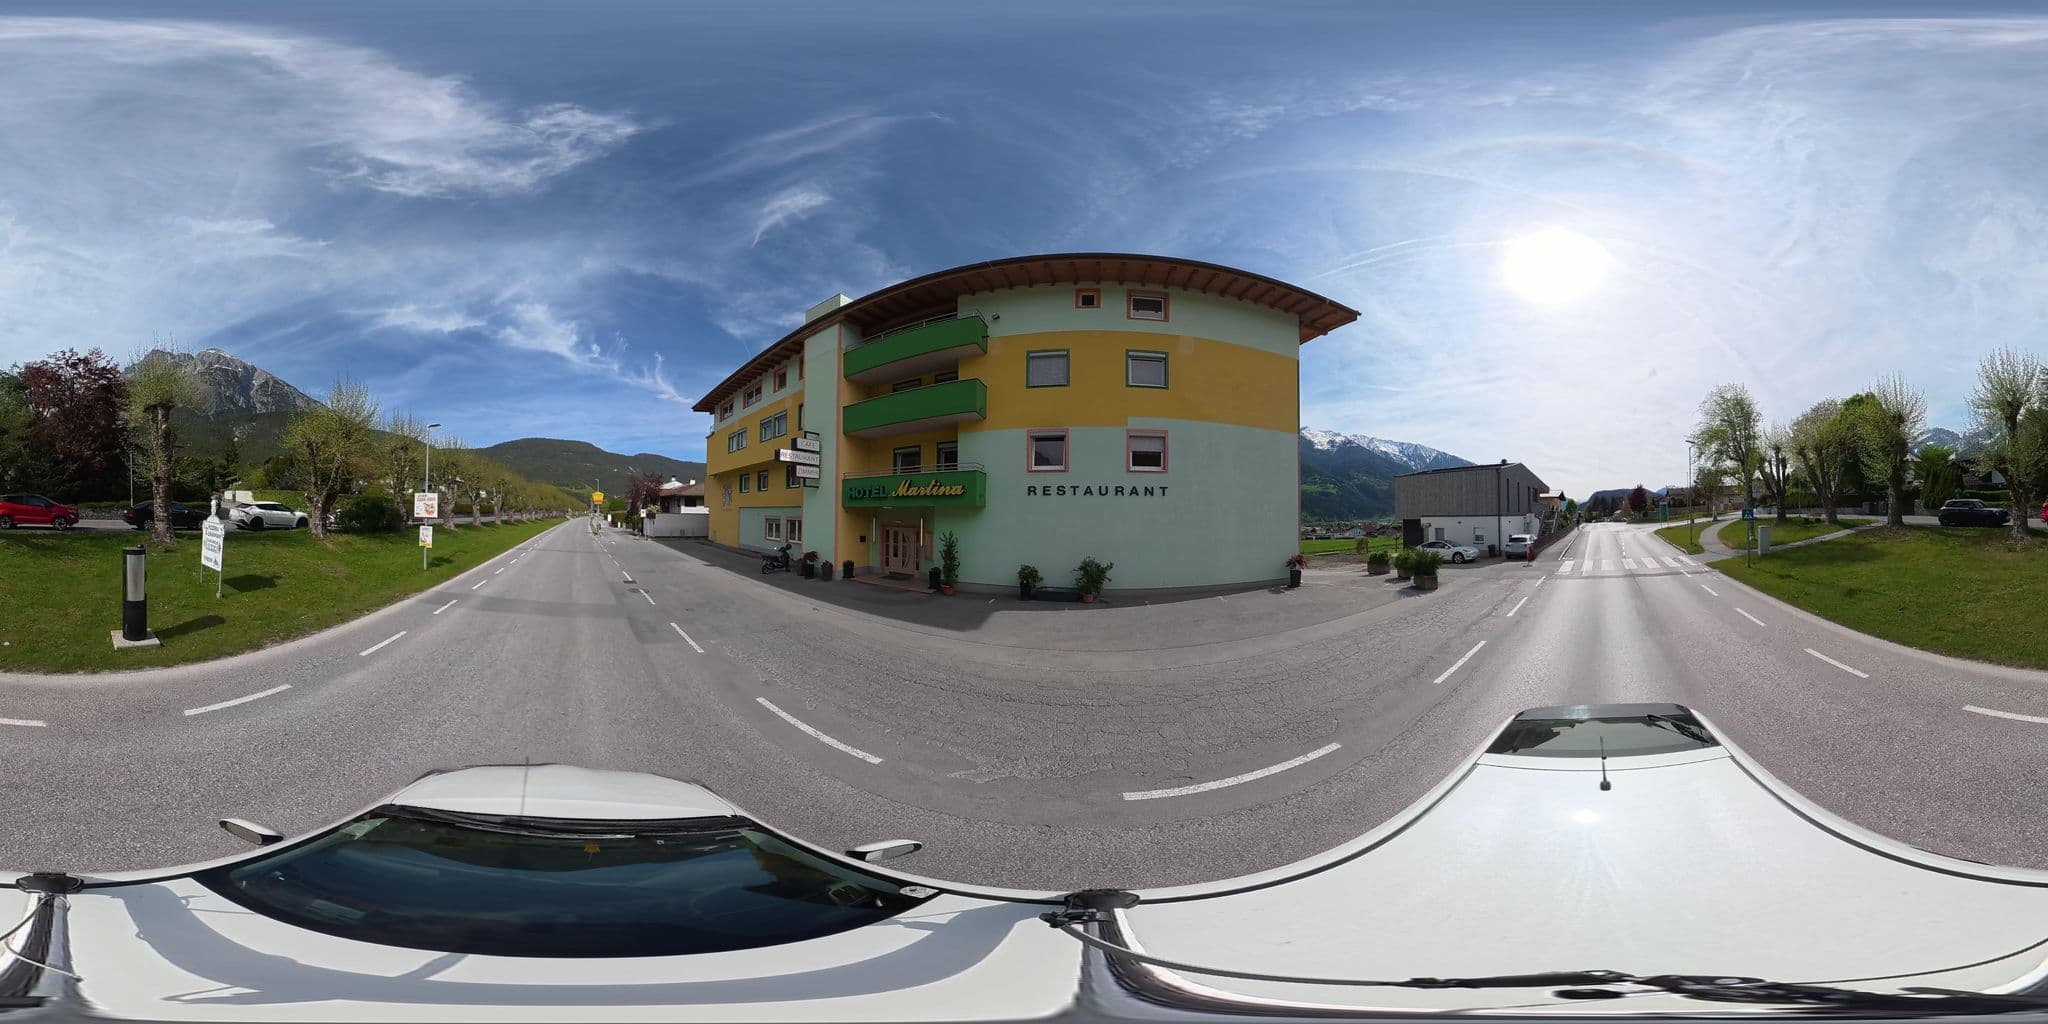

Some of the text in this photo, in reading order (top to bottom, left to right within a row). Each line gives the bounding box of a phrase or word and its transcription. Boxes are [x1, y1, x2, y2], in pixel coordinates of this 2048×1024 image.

[780, 451, 819, 465] RESTAURANT
[797, 467, 818, 476] ZIMMER
[847, 479, 965, 500] HOTEL Martina
[1027, 485, 1168, 497] RESTAURANT
